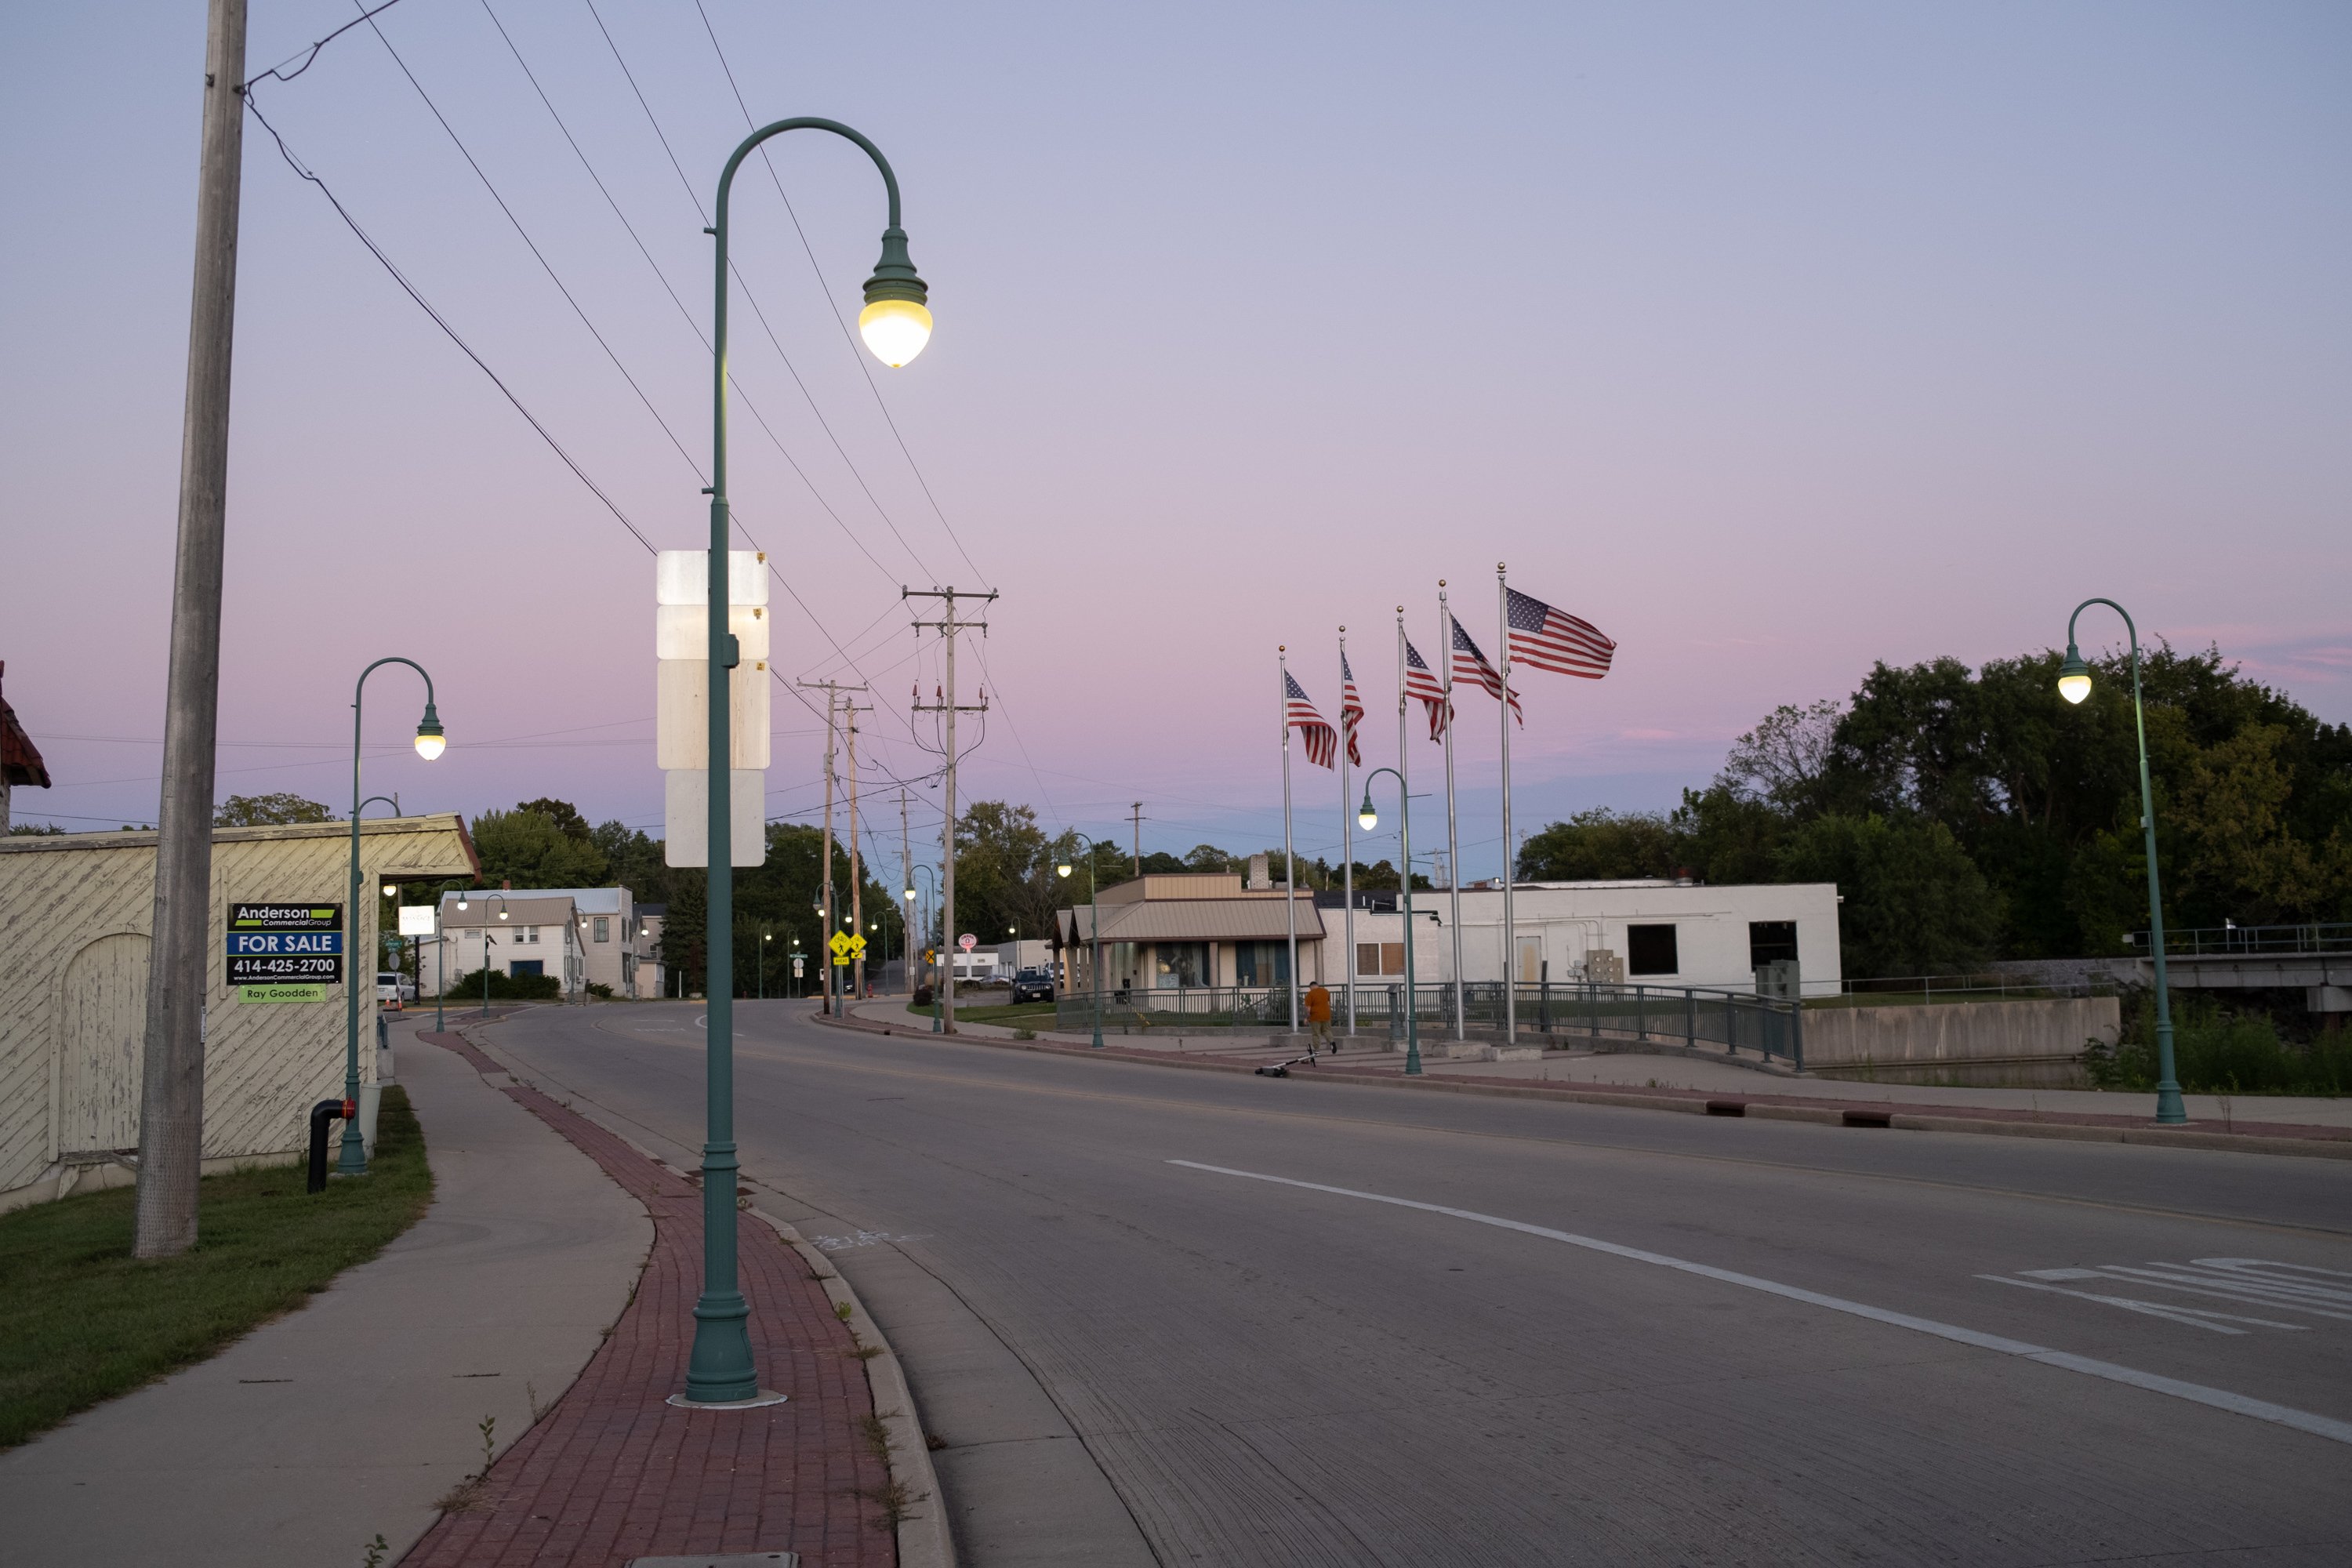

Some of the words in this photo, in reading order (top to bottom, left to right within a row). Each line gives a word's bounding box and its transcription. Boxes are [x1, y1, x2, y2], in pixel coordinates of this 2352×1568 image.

[238, 906, 310, 919] Anderson
[238, 935, 278, 953] FOR
[285, 935, 332, 952] SALE
[234, 959, 335, 972] 414-425-2700
[247, 989, 266, 1000] Ray
[269, 989, 318, 998] Goodden
